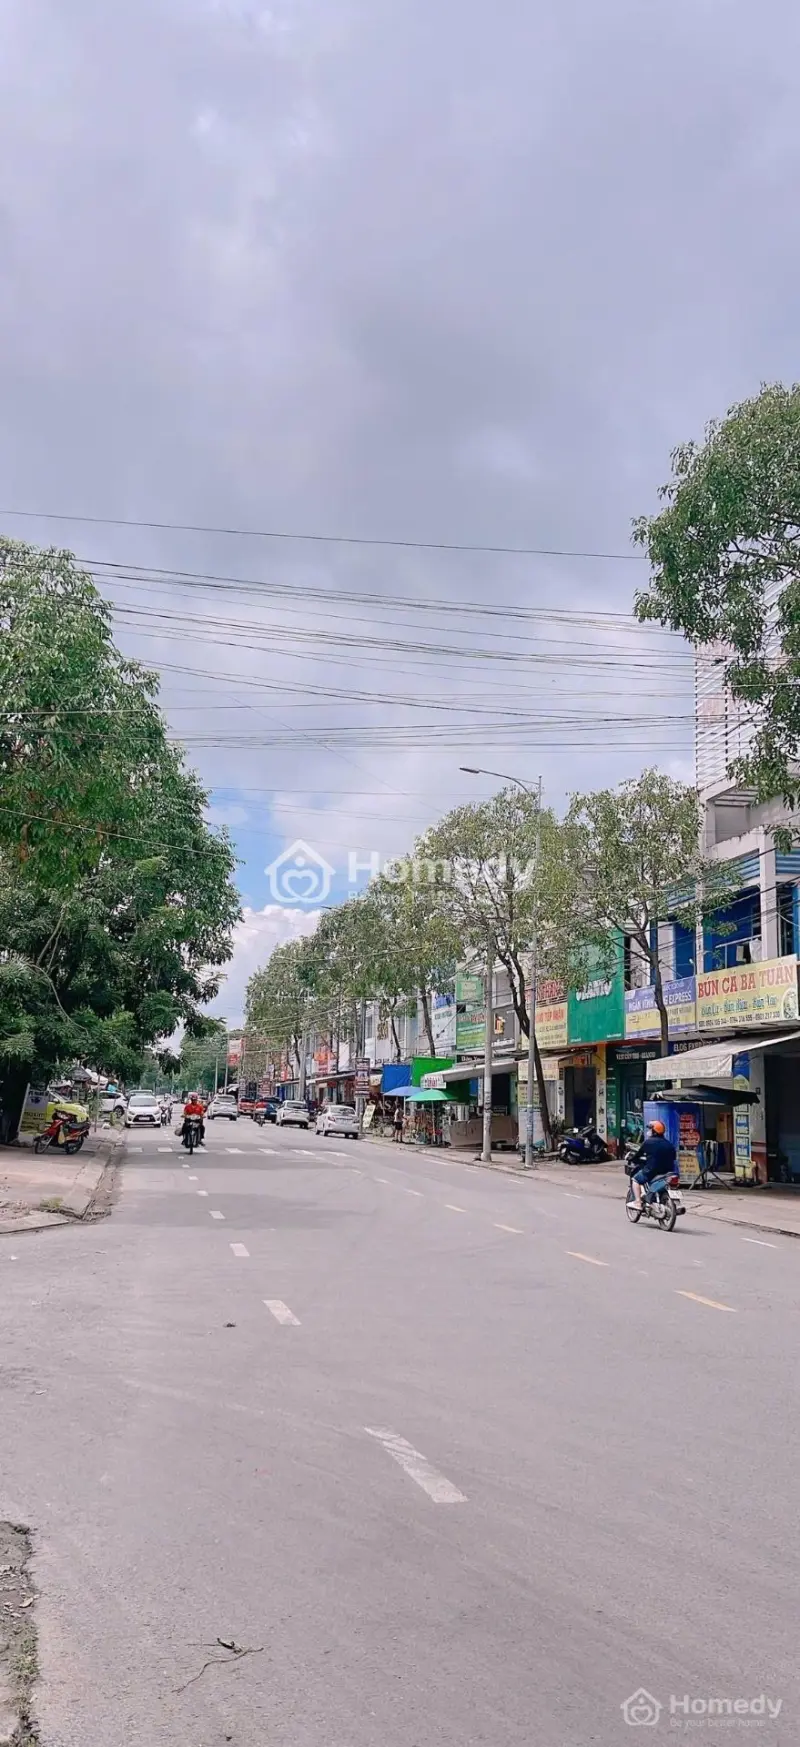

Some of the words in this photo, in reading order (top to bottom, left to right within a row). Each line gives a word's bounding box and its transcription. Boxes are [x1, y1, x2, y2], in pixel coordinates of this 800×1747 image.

[698, 976, 719, 998] BÚN
[722, 971, 738, 994] CÁ
[740, 972, 756, 991] BA
[668, 990, 692, 1004] EXPRESS
